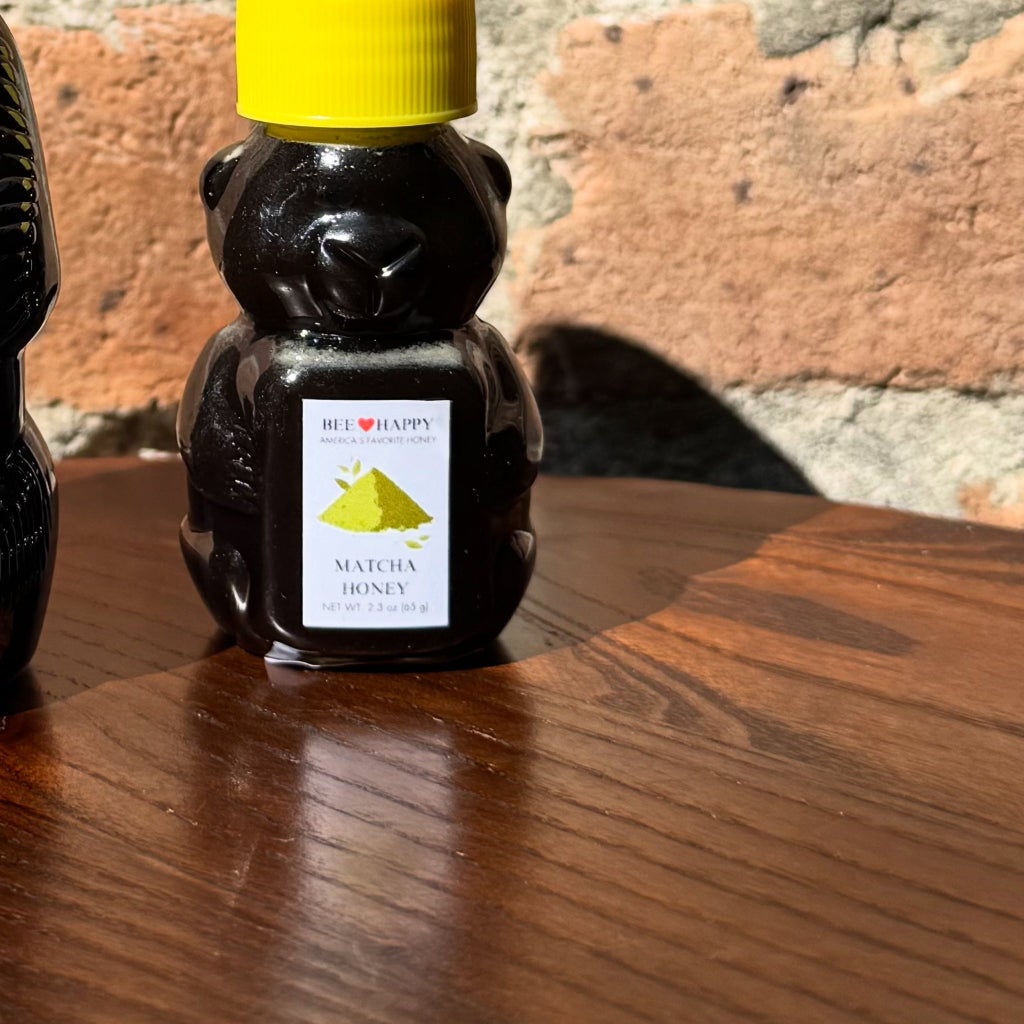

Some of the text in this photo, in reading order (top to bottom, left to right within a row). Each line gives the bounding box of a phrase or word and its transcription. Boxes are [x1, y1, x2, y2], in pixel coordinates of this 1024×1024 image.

[322, 417, 433, 431] BEE HAPPY
[320, 436, 365, 445] AMERICAS
[406, 435, 436, 444] HONEY
[335, 558, 417, 573] MATCHA
[342, 581, 409, 595] HONEY
[322, 602, 341, 612] NET
